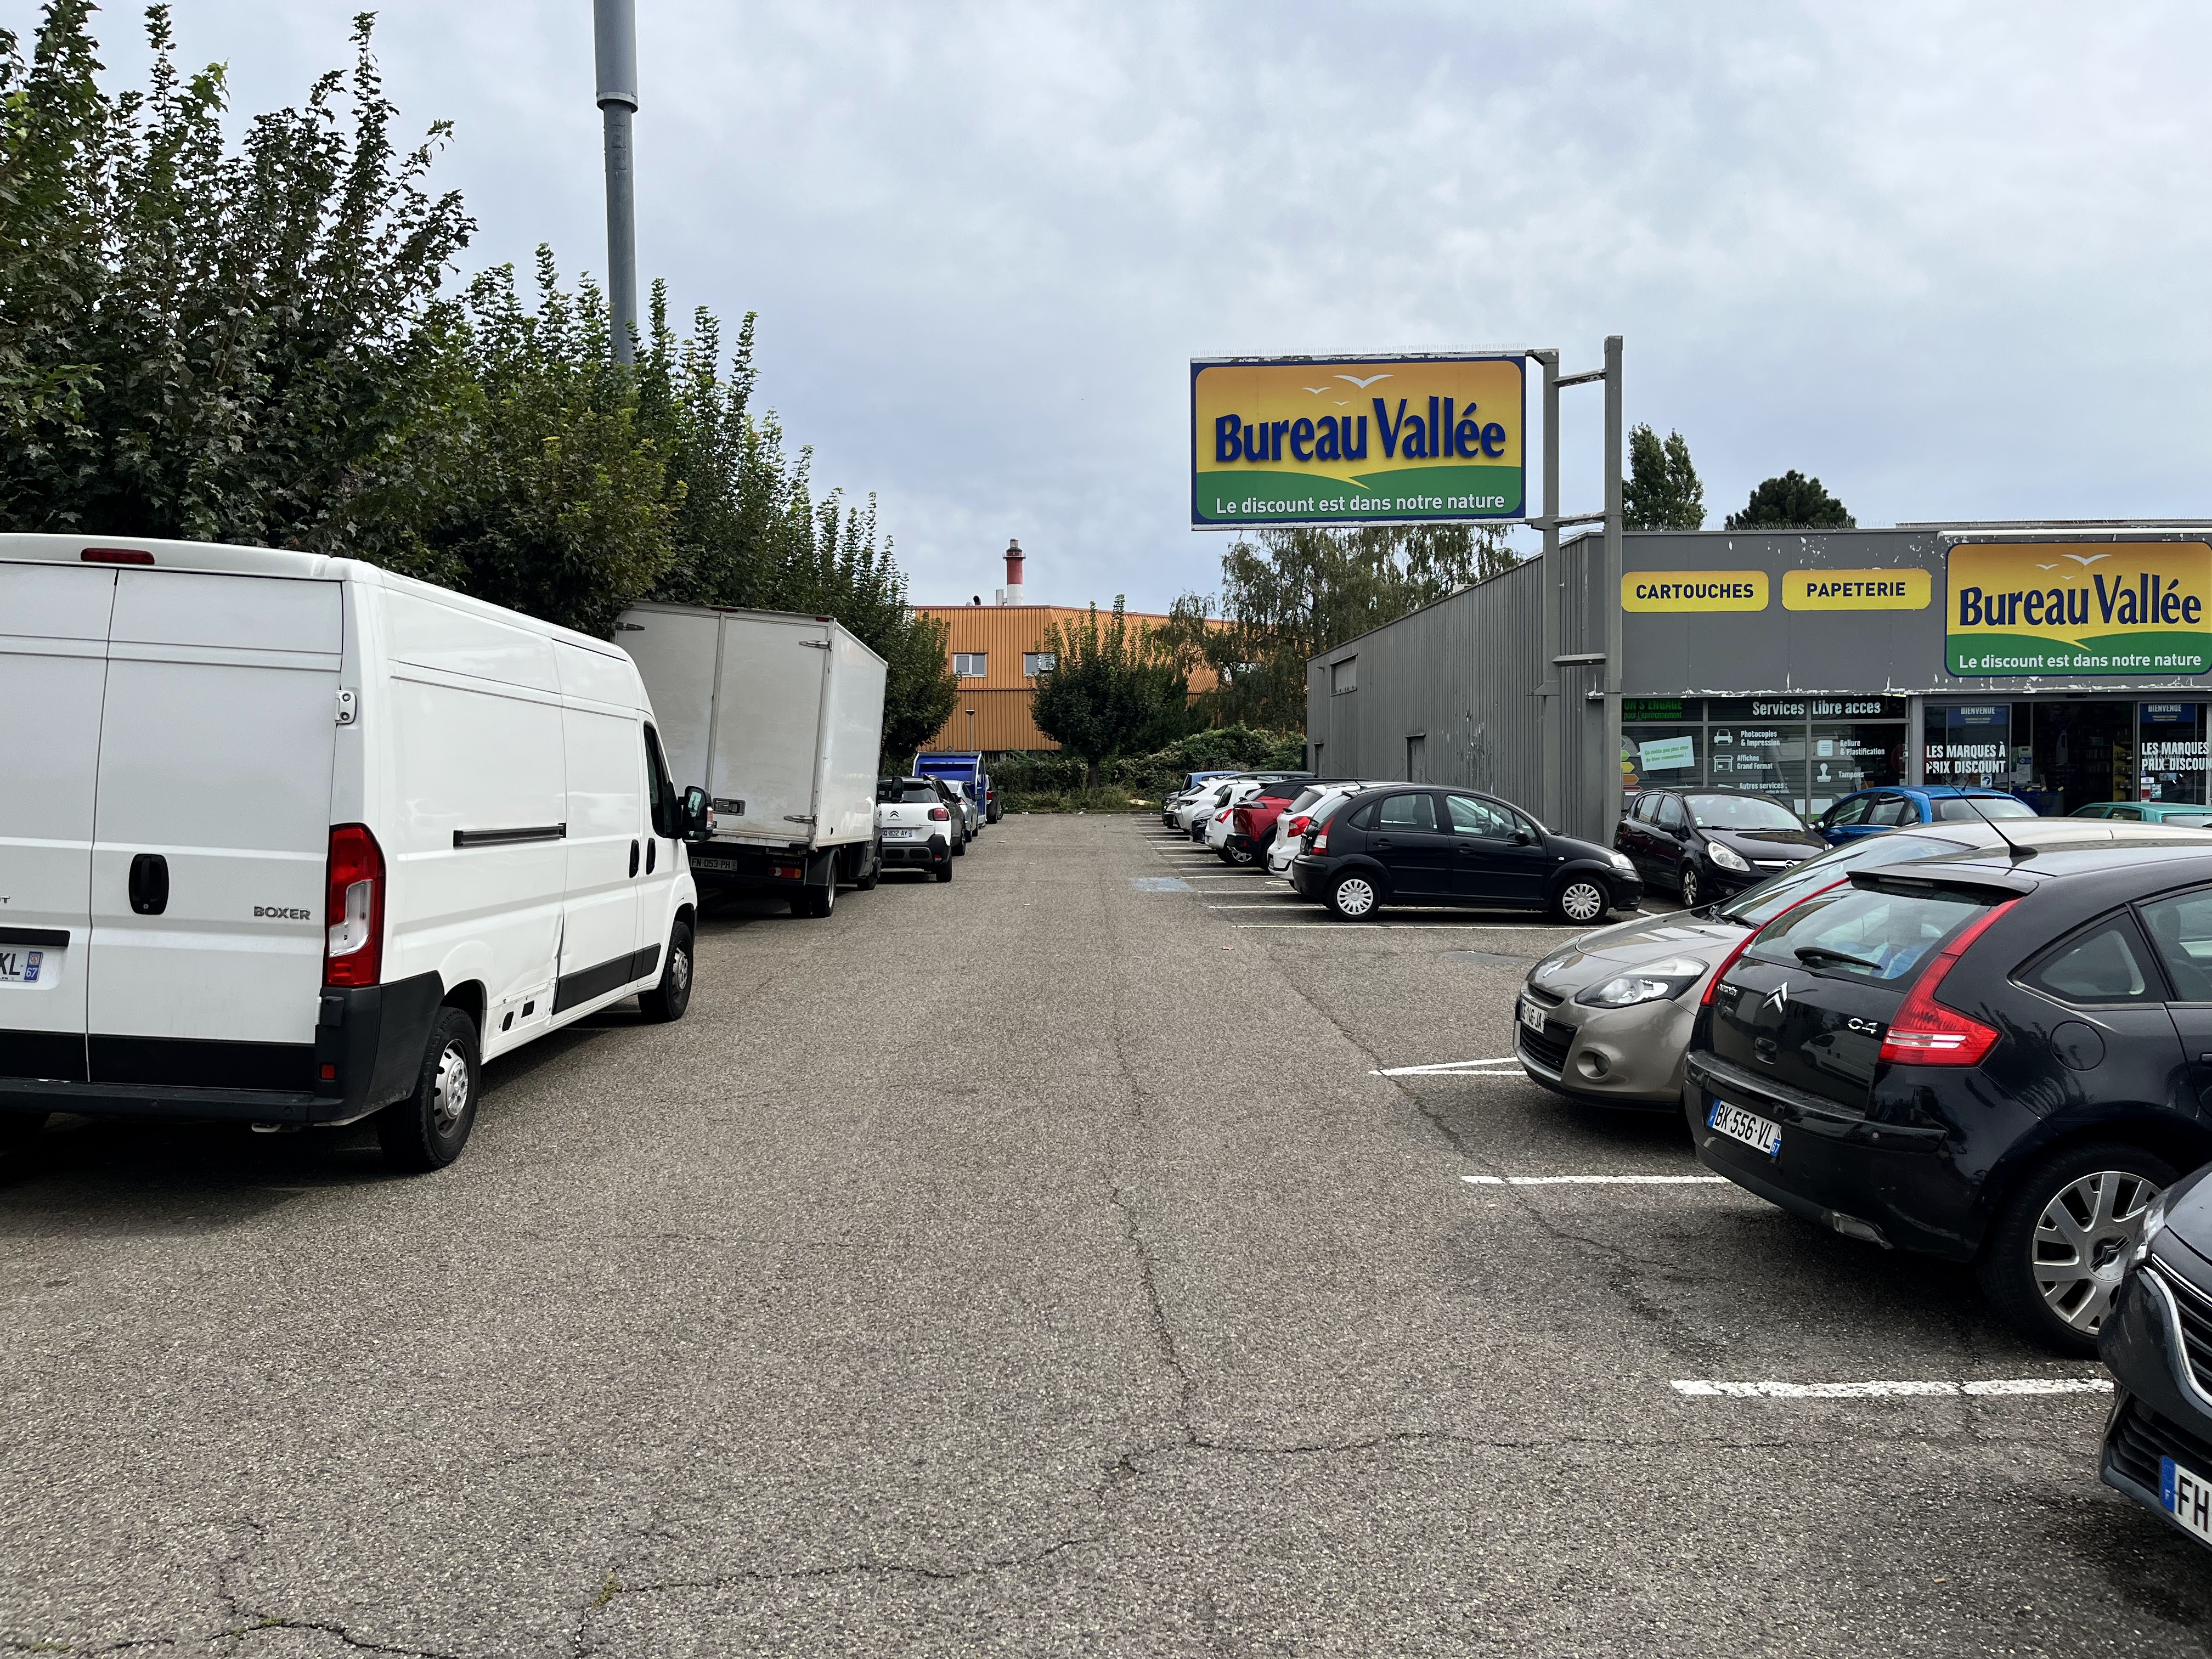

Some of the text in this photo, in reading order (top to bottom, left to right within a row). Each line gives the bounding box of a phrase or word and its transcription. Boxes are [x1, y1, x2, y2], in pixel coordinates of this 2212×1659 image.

[1215, 396, 1506, 462] Bureau Vallée
[1216, 494, 1505, 514] Le discount est dans notre nature
[1636, 583, 1754, 600] CARTOUCHES
[1807, 582, 1906, 597] PAPETERIE
[1959, 572, 2202, 626] Bureau Vallée
[1959, 653, 2202, 669] Le discount est dans notre nature
[1752, 701, 1804, 715] Services
[1812, 699, 1842, 714] Libre
[1960, 707, 1995, 715] BIENVENUE
[2148, 704, 2182, 713] BIENVENUE
[1740, 730, 1778, 739] Photocopies
[1747, 739, 1780, 748] Impression
[1839, 739, 1861, 747] Reliure
[1926, 741, 2006, 759] LES MARQUES À
[2141, 741, 2210, 757] LES MARQUES
[1846, 747, 1885, 755] Plastification
[1926, 760, 1950, 774] PRIX
[1954, 760, 2006, 774] DISCOUNT
[2141, 757, 2212, 771] PRIX DISCOUN
[1838, 771, 1865, 780] Tampons
[1739, 782, 1758, 790] Autres
[253, 905, 311, 920] BOXER
[26, 967, 38, 978] 67
[1848, 1018, 1878, 1034] C4
[1771, 1142, 1780, 1153] 67
